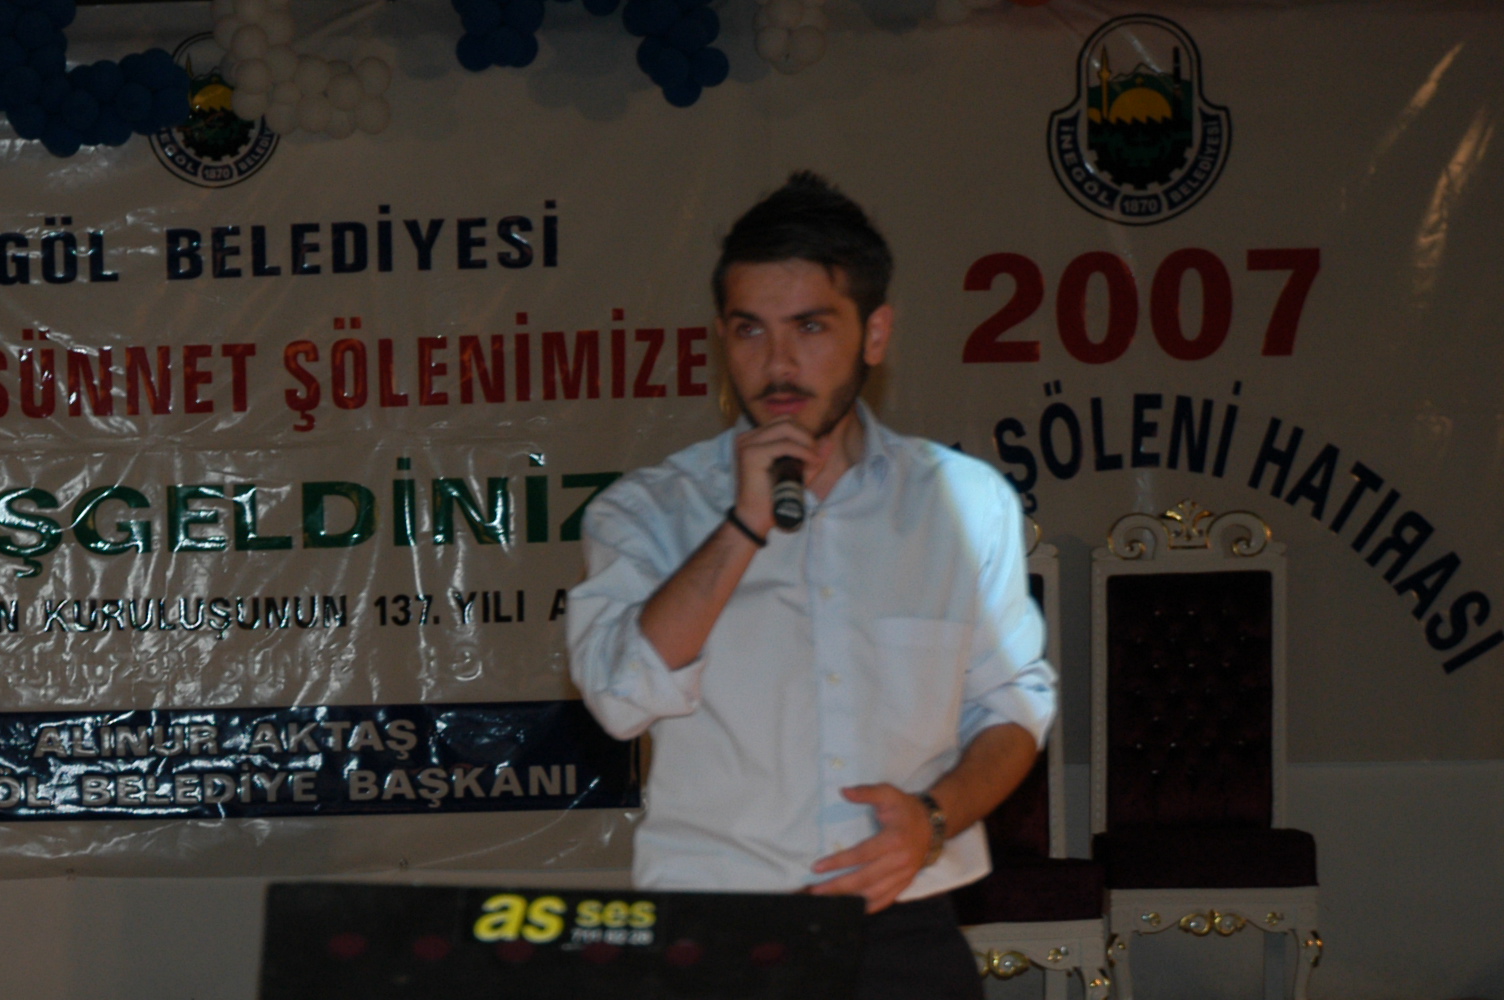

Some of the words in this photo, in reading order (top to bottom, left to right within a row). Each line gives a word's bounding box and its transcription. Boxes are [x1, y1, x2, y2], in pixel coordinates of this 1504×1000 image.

[203, 166, 231, 179] 1870
[1122, 199, 1159, 214] 1870
[166, 200, 558, 280] BELEDİYESİ
[961, 247, 1321, 365] 2007
[284, 307, 708, 433] ŞÖLENİMİZE
[994, 379, 1242, 515] ŞÖLENİ
[44, 595, 348, 641] KURULUŞUNUN
[374, 595, 440, 627] 137.
[457, 589, 525, 624] YILI
[251, 718, 418, 760] AKTAŞ
[81, 763, 318, 808] BELEDİYE
[349, 763, 578, 808] BAŞKANI
[472, 893, 568, 944] as
[575, 899, 658, 929] ses
